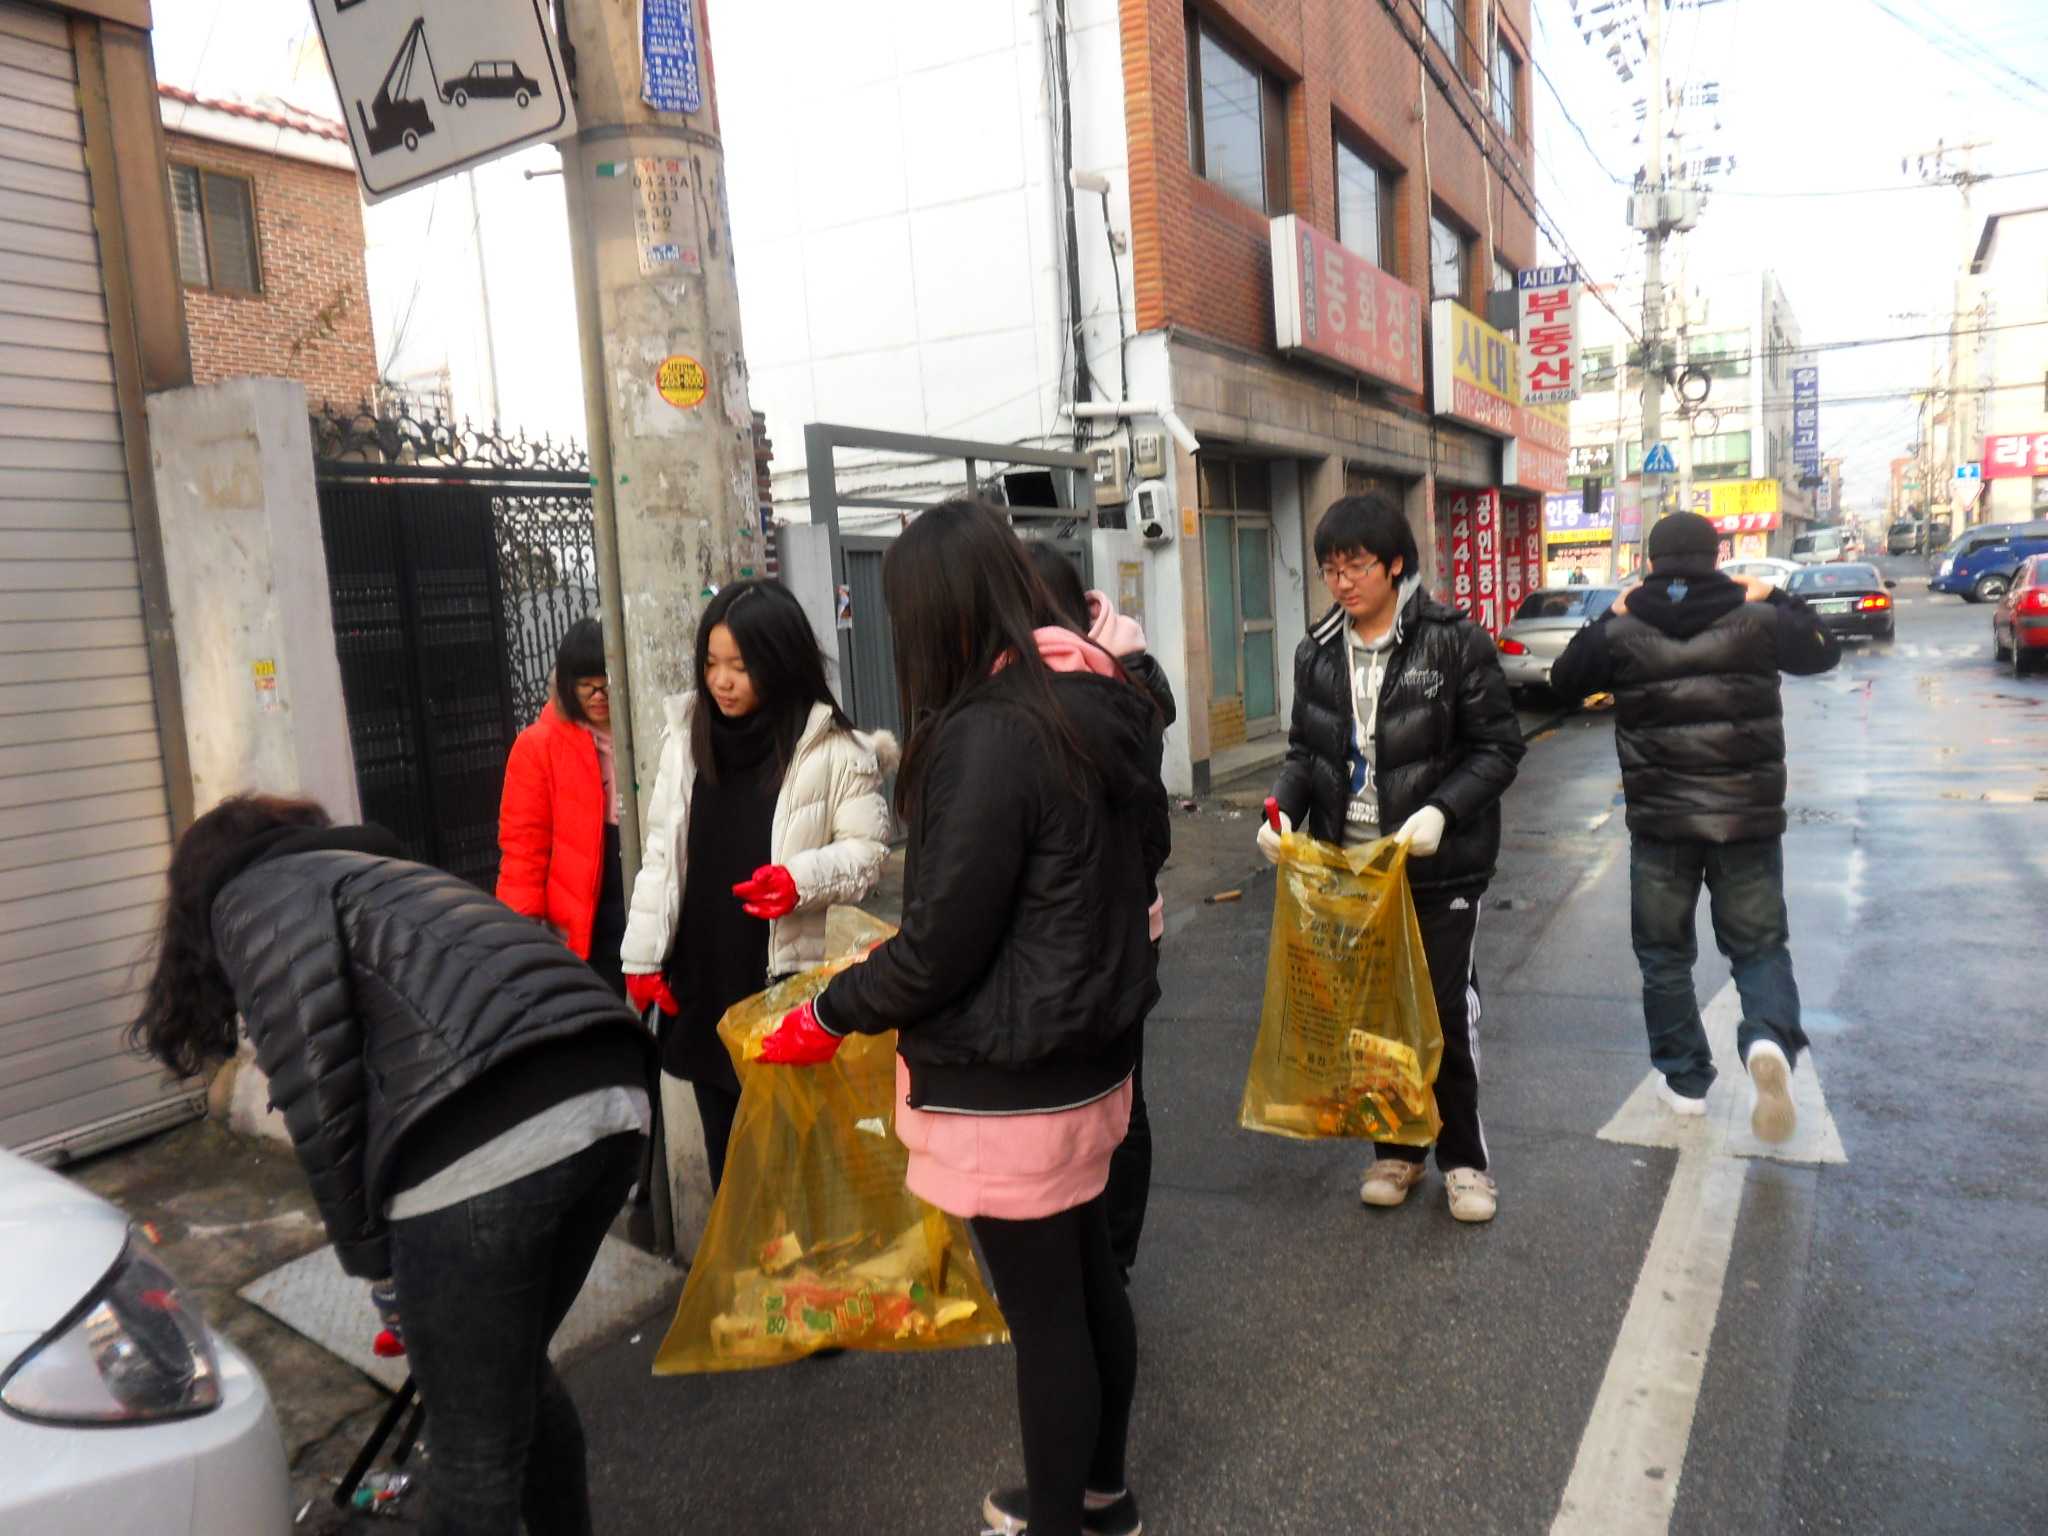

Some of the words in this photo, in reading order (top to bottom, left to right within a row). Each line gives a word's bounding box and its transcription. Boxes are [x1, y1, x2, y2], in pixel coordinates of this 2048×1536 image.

[648, 189, 678, 202] 033
[1323, 249, 1405, 360] 동화장
[1525, 288, 1575, 391] 부동산
[1477, 494, 1495, 640] 공인중개
